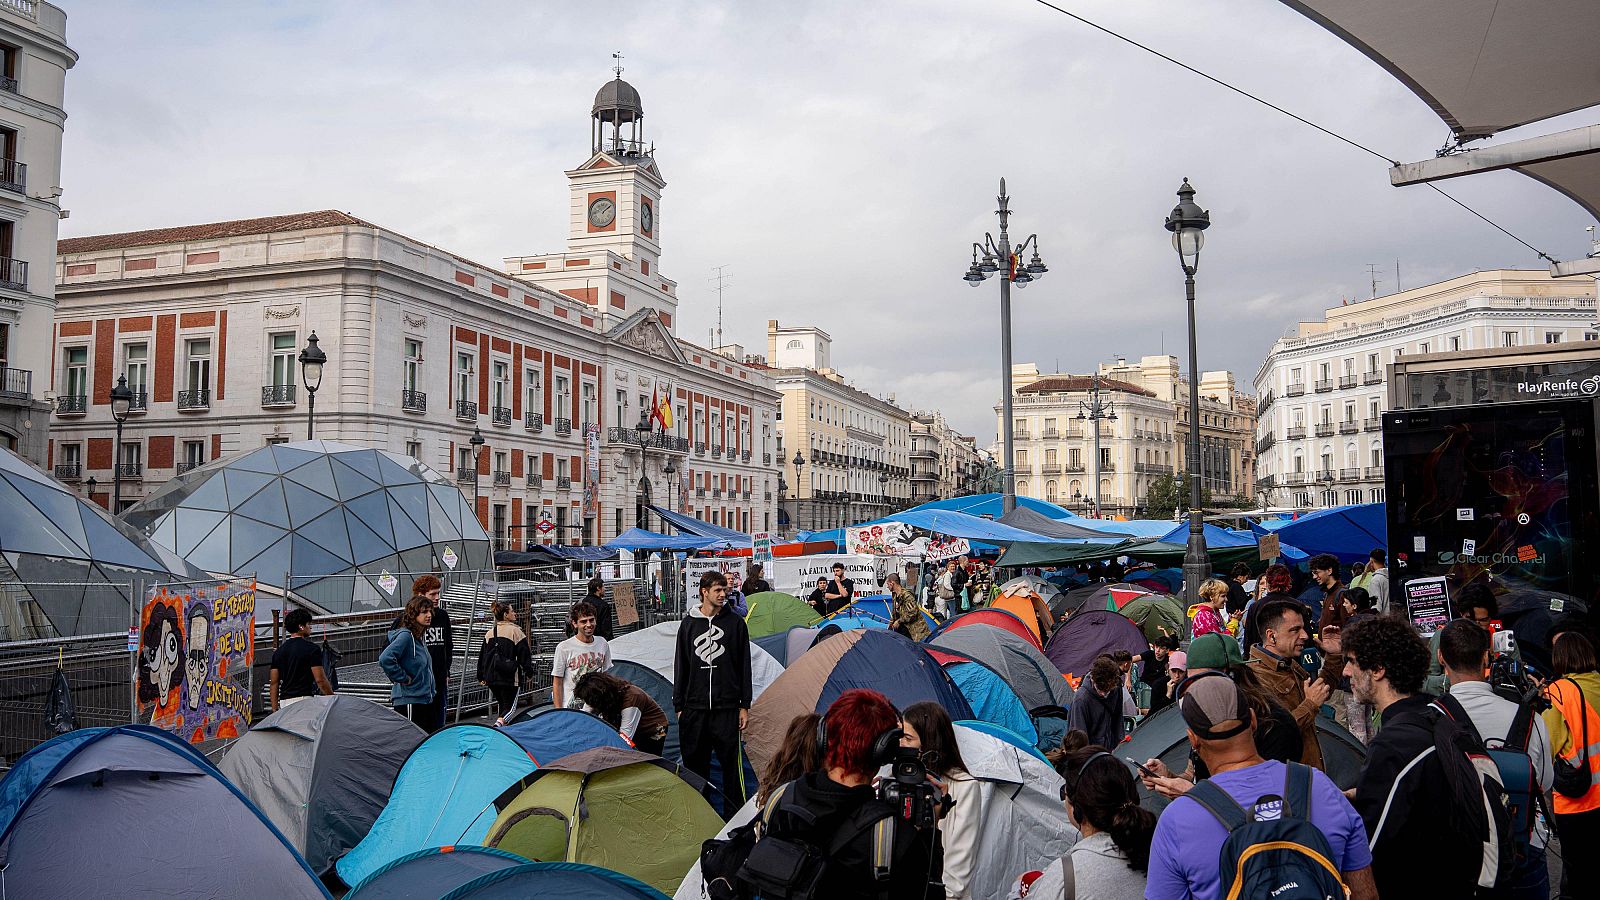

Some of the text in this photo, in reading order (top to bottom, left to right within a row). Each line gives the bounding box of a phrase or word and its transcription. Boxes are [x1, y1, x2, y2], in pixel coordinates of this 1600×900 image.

[1517, 379, 1578, 394] PlayRenfe
[925, 541, 968, 560] AVARICIA
[1464, 540, 1474, 550] ie
[1456, 552, 1488, 564] Clear
[1492, 552, 1546, 564] Chael
[808, 566, 828, 576] FALTA
[213, 590, 255, 621] EL TEATRO
[424, 627, 445, 642] ESEL
[219, 631, 246, 655] DE LA
